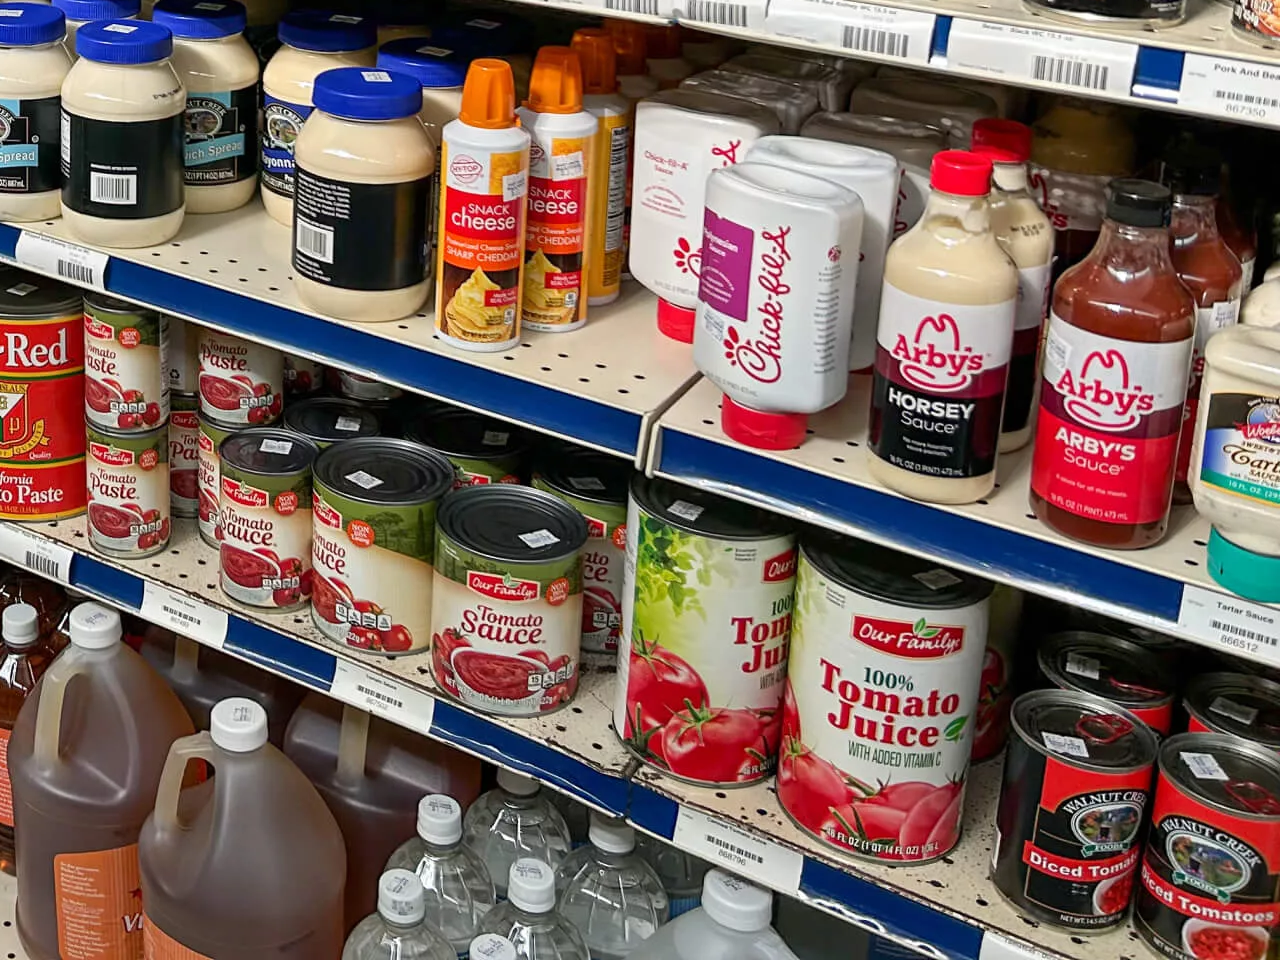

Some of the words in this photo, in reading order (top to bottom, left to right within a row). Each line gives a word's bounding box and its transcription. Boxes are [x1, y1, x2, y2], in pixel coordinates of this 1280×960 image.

[1215, 63, 1236, 75] Pork
[1240, 67, 1260, 78] And
[530, 188, 571, 200] SNACK
[452, 207, 516, 231] cheese
[468, 204, 509, 216] SNACK
[447, 249, 474, 261] SHARP
[736, 226, 791, 384] Chick-fil-A
[209, 339, 248, 357] Tomato
[891, 334, 984, 378] Arby's
[888, 386, 975, 420] HORSEY
[1056, 369, 1155, 413] Arby's
[900, 410, 955, 435] Sauce
[1054, 425, 1136, 461] ARBY'S
[1063, 447, 1121, 476] Sauce
[91, 475, 136, 499] Paste
[98, 467, 136, 484] Tomato
[18, 484, 64, 504] Paste
[227, 507, 273, 531] Tomato
[477, 604, 543, 628] Tomato
[1216, 601, 1244, 616] Tartar
[1246, 609, 1274, 624] Sauce
[461, 609, 542, 644] Sauce
[859, 623, 895, 648] Our
[896, 628, 956, 654] Family
[820, 658, 960, 717] Tomato
[864, 666, 914, 692] 100%
[828, 699, 940, 748] Juice
[848, 741, 871, 758] WITH
[873, 749, 900, 767] ADDED
[902, 752, 934, 768] VITAMIN
[936, 751, 941, 767] C
[1030, 851, 1082, 878] Diced
[1088, 851, 1137, 878] Tomat
[1141, 867, 1173, 904] Diced
[1178, 894, 1274, 922] Tomatoes
